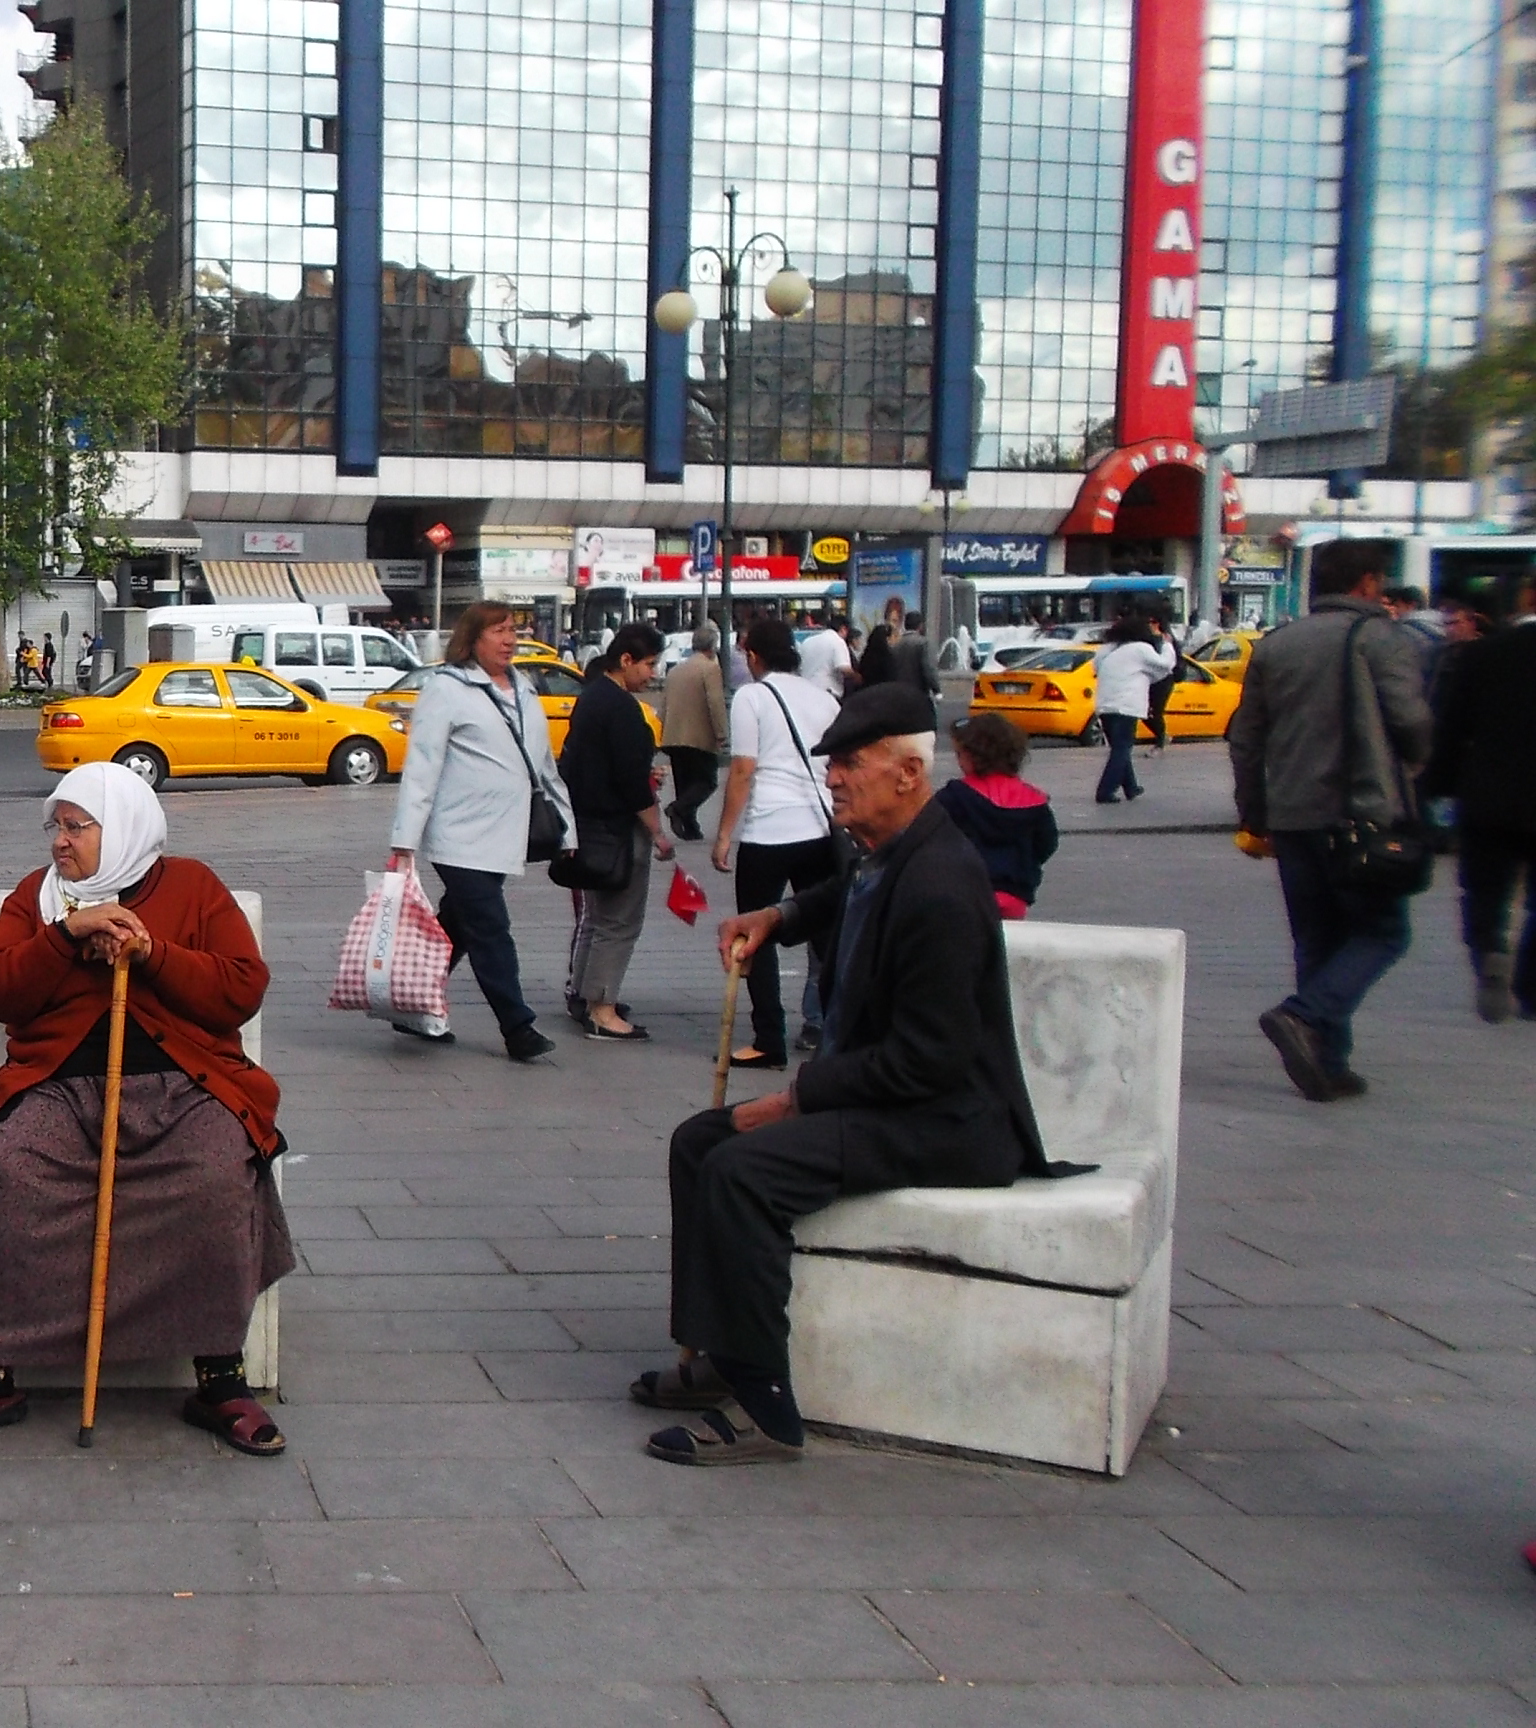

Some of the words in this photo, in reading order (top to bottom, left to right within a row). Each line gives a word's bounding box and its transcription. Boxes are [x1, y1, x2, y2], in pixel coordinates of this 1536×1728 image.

[1150, 139, 1197, 388] GAMA
[698, 525, 711, 569] P
[615, 572, 641, 582] avea
[254, 732, 266, 741] 06
[268, 732, 275, 741] T
